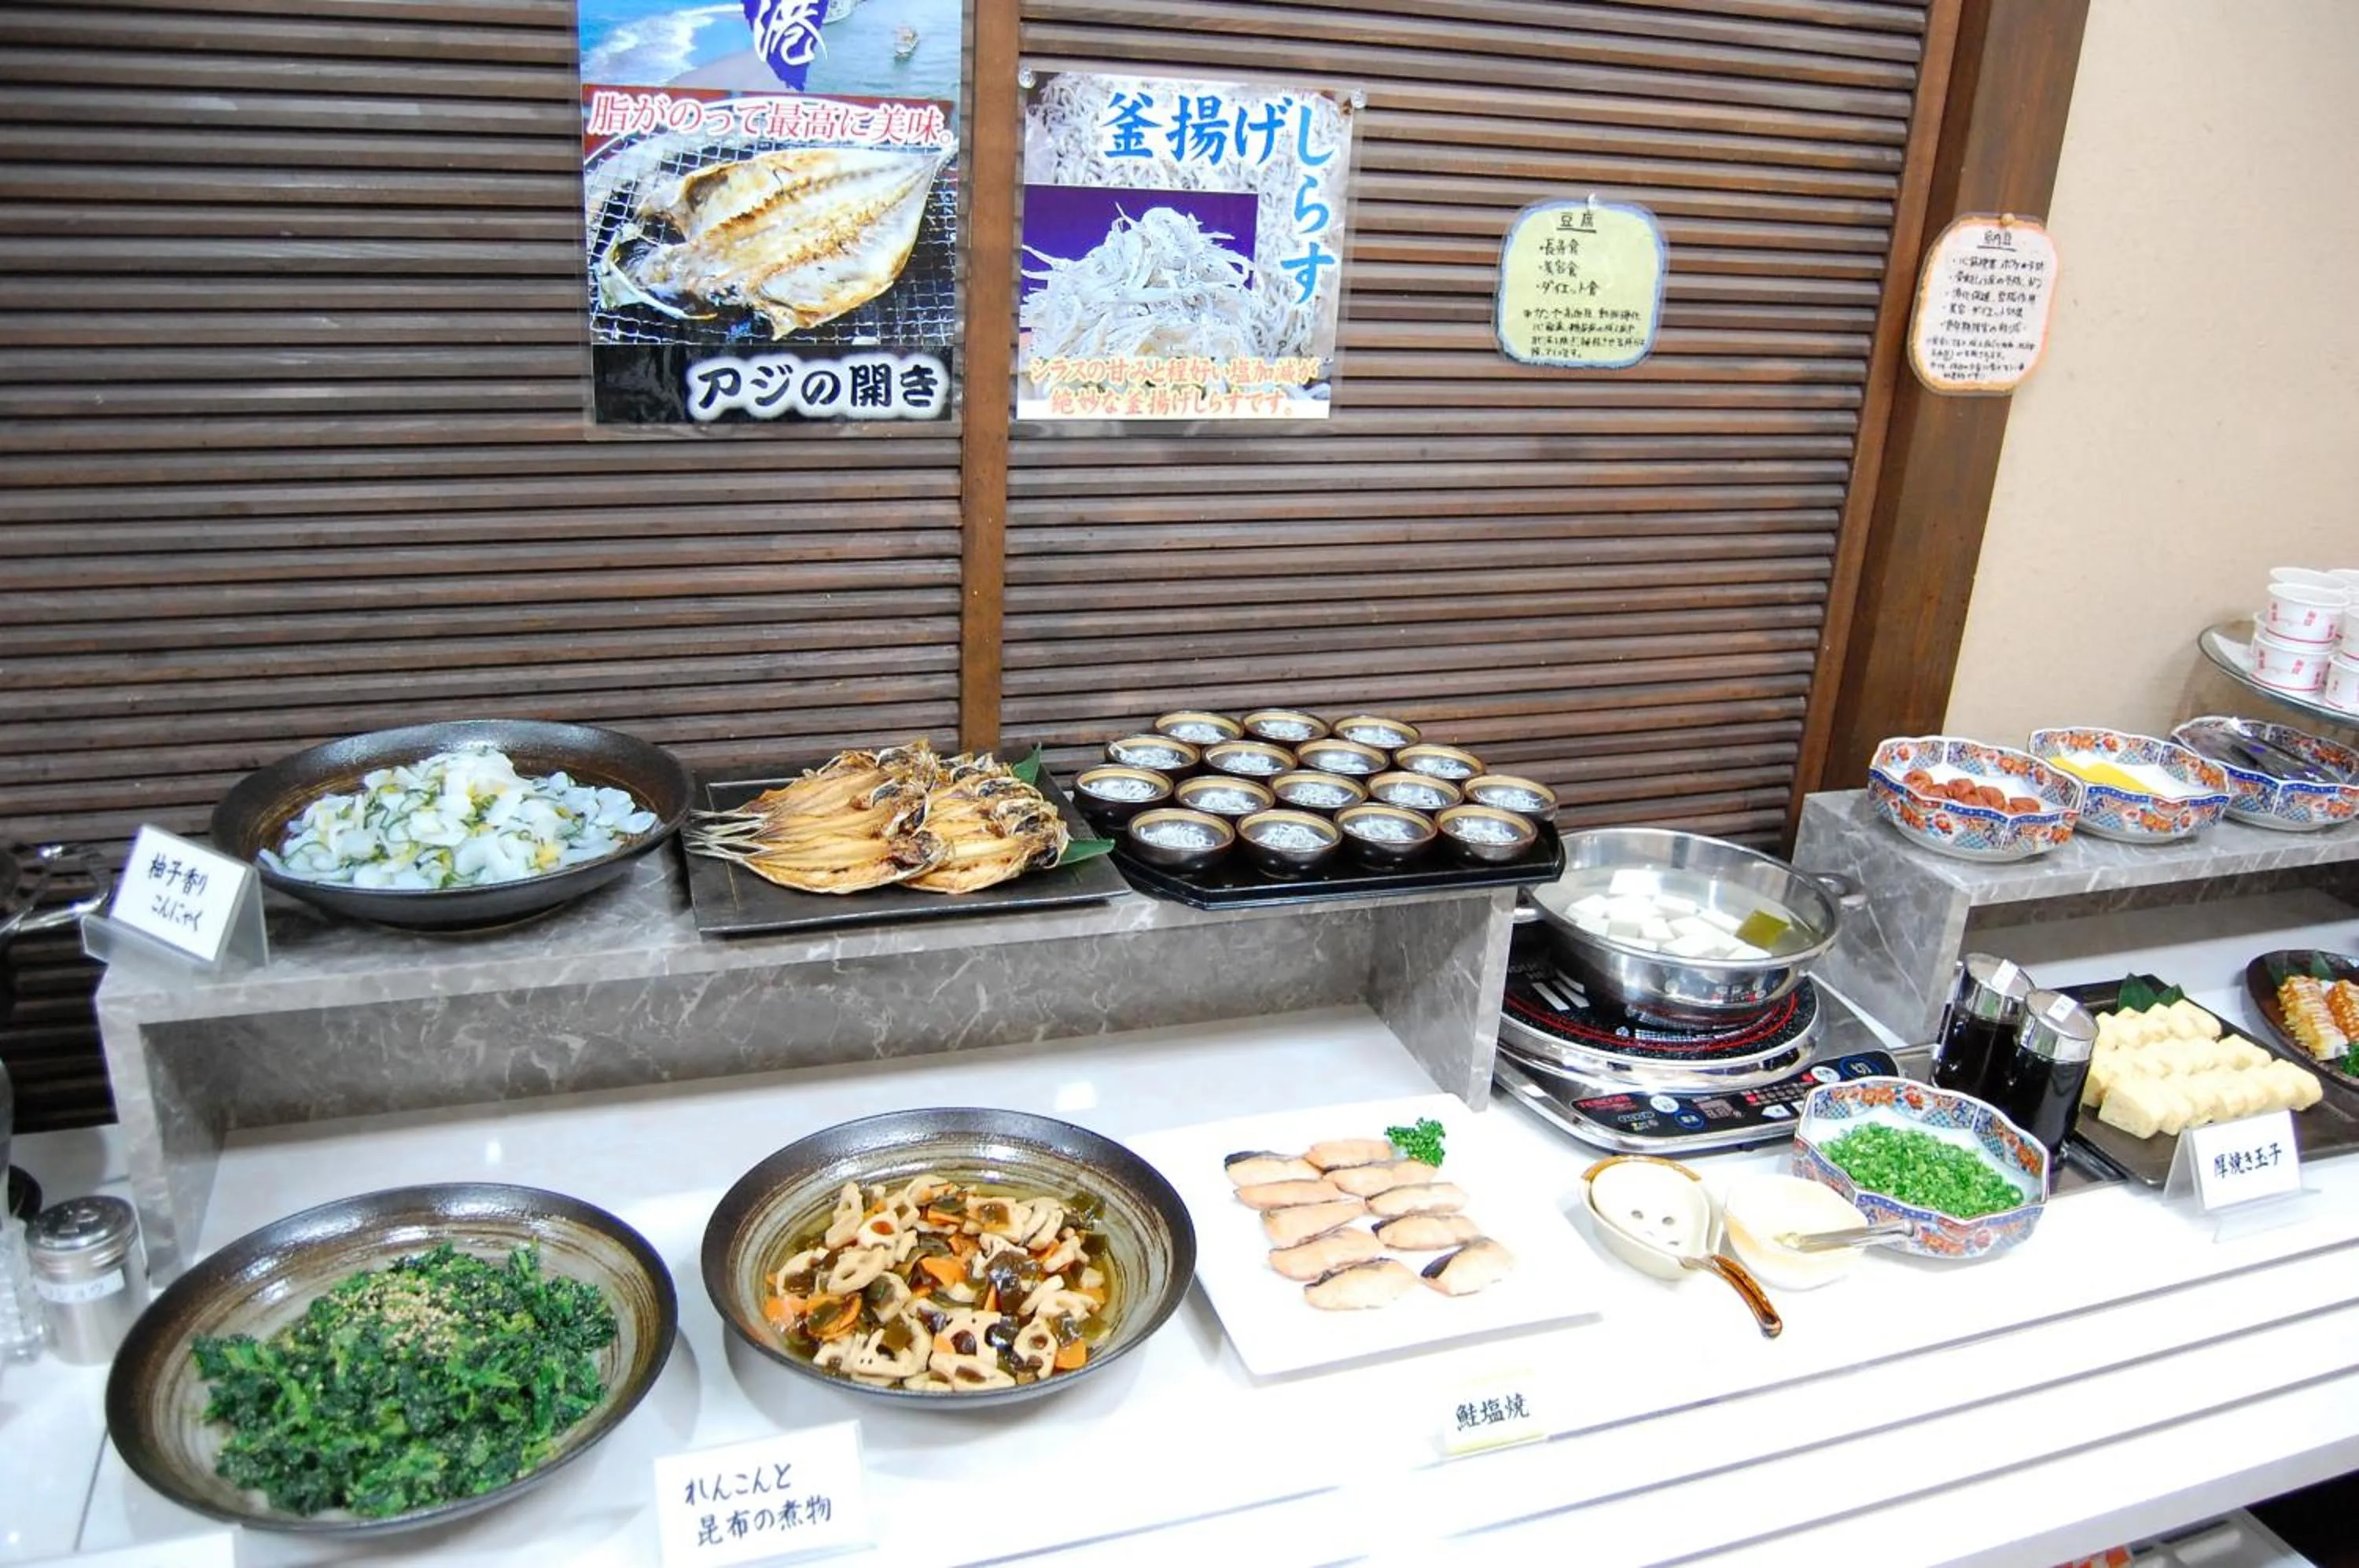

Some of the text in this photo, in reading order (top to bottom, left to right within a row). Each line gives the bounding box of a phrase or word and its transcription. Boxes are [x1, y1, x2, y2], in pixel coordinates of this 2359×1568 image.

[590, 93, 955, 146] 脂がのって最高に美味。
[1102, 92, 1335, 304] 釜揚げ しらす
[697, 364, 939, 410] アジの開き
[151, 894, 204, 932] こんにゃく
[2214, 1142, 2283, 1179] 厚焼き玉子
[1456, 1392, 1531, 1431] 鮭塩焼
[684, 1463, 793, 1506] れんこんと
[697, 1494, 832, 1547] 昆布の煮物
